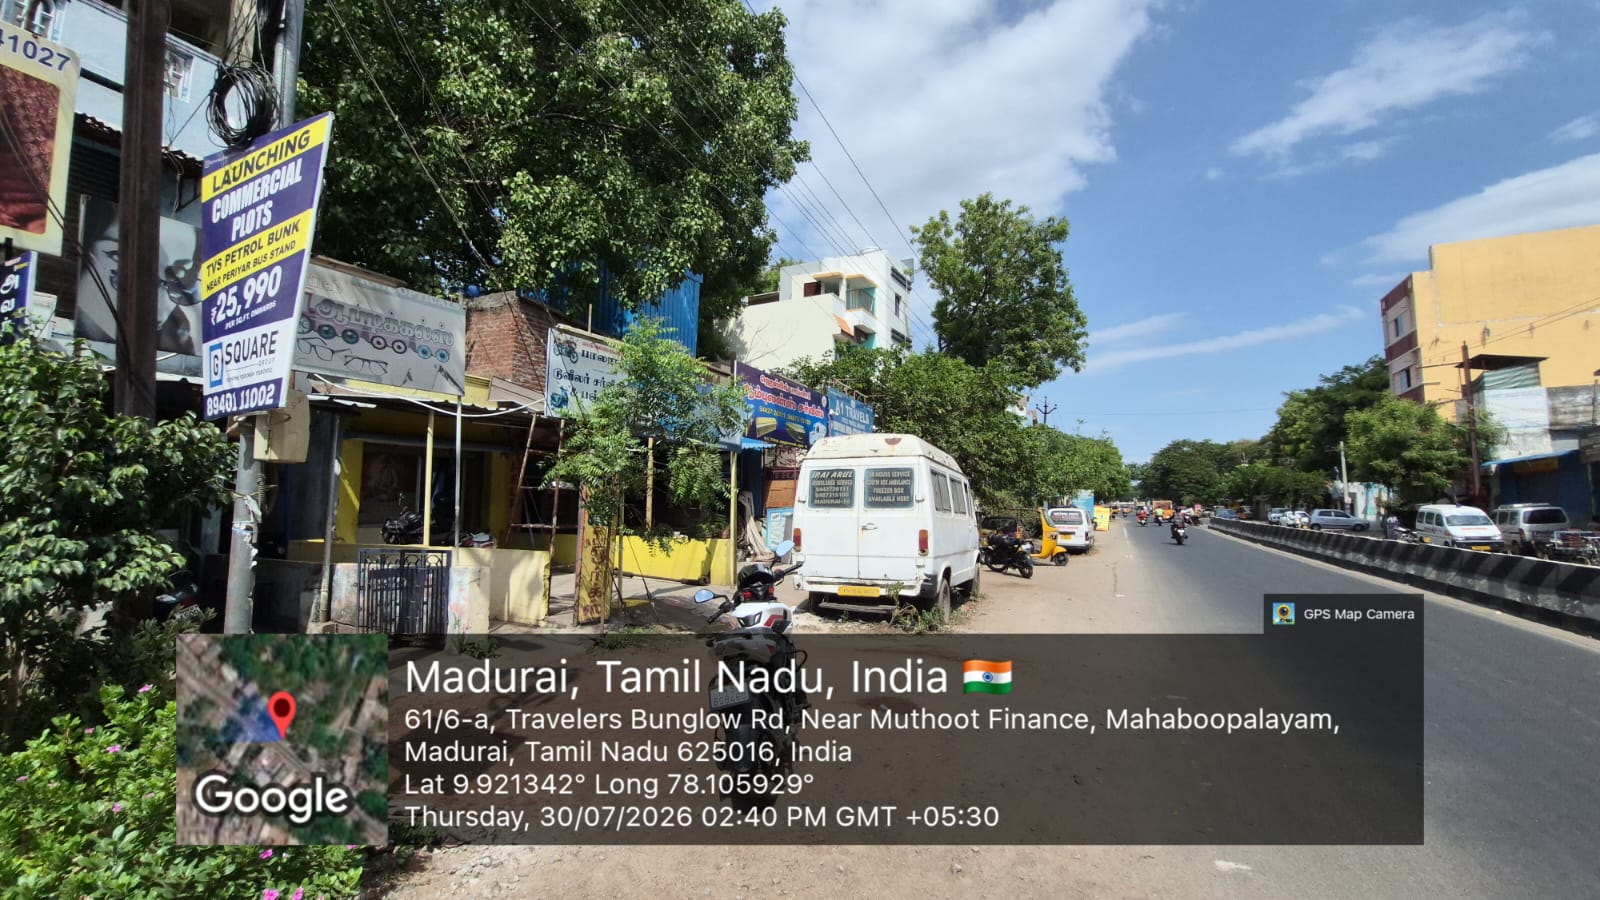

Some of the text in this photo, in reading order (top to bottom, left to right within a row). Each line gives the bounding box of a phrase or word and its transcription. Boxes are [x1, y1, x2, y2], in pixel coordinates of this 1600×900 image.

[212, 130, 310, 193] LAUNCHING
[212, 158, 302, 223] COMMERCIAL
[231, 200, 273, 242] PLOTS
[206, 219, 300, 277] TVS PETROL BUNK
[206, 240, 296, 292] NEAR PERIYAR BUS STAND
[224, 330, 279, 365] SQUARE
[206, 383, 276, 416] 89401 11002
[845, 405, 870, 424] TRAVELS
